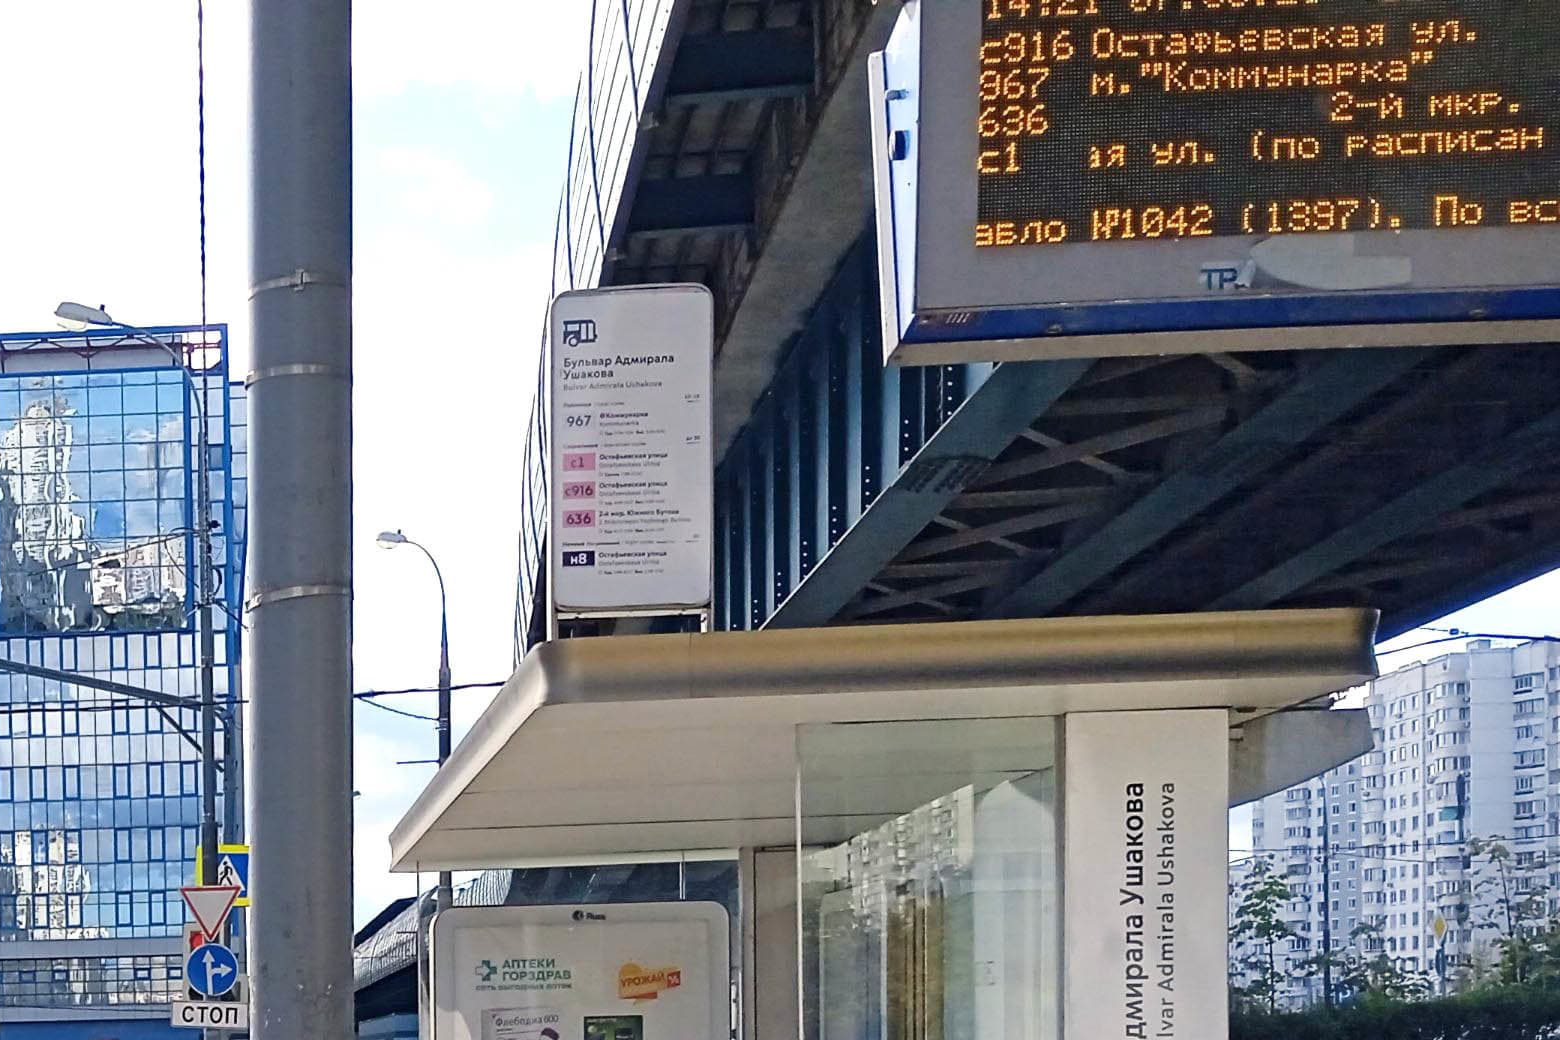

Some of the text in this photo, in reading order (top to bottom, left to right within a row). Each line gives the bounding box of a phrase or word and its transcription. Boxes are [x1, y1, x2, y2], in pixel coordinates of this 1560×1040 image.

[1092, 24, 1385, 58] Остафьевская
[1411, 20, 1476, 44] ул.
[979, 67, 1049, 100] 967
[978, 91, 1520, 137] 636 2-й мкр.
[1152, 142, 1215, 164] ул.
[1253, 130, 1319, 160] (по
[1347, 127, 1543, 157] расписан
[1436, 194, 1482, 226] По
[563, 355, 674, 369] Бульвар Адмирала
[563, 370, 614, 380] Ушакова
[566, 415, 591, 427] 967
[566, 513, 591, 524] 636
[1119, 783, 1144, 906] Ушакова
[1157, 782, 1175, 886] Ushakova
[1157, 892, 1175, 992] Admirala
[502, 959, 555, 969] АПТЕКИ
[502, 970, 572, 981] ГОРЗДРАВ
[182, 1006, 238, 1024] СТОП
